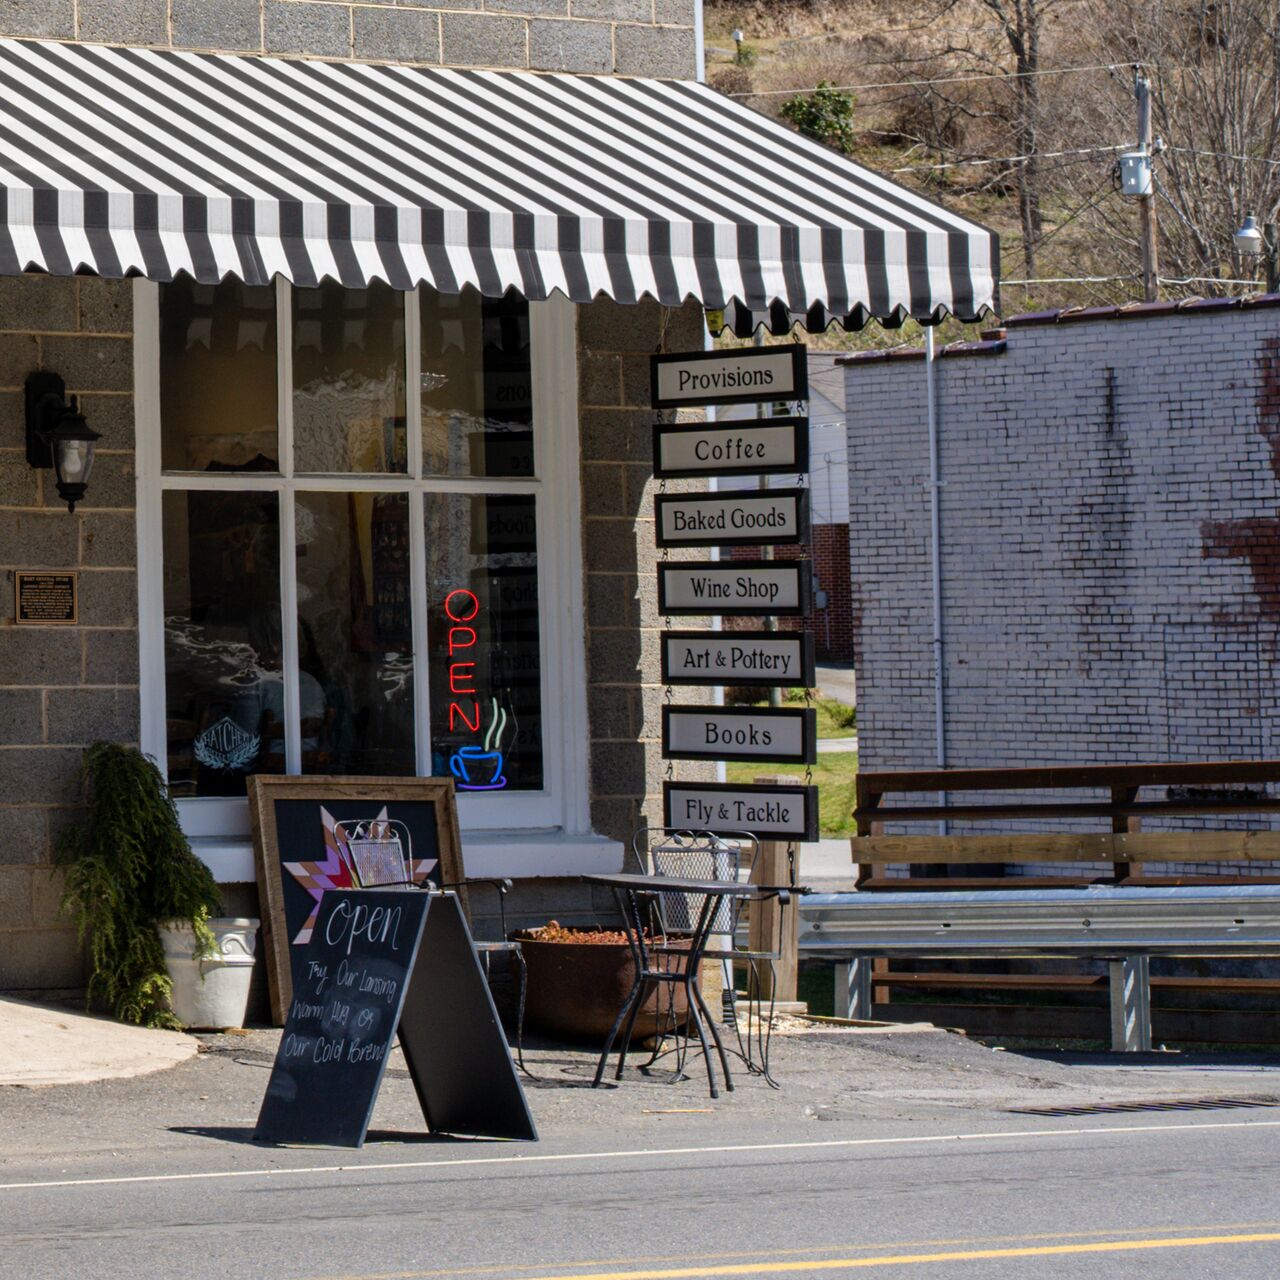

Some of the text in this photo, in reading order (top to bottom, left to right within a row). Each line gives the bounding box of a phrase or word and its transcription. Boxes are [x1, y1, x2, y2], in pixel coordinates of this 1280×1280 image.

[678, 366, 774, 391] Provisions
[694, 438, 766, 461] Coffee
[673, 506, 786, 531] Baked Goods
[689, 577, 779, 602] Wine Shop
[445, 588, 480, 732] OPEN
[683, 647, 791, 674] Art & Pottery
[705, 722, 772, 746] Books
[686, 799, 790, 825] Fly & Tackle
[325, 898, 402, 955] Open
[308, 959, 397, 1003] Try Our Lansing
[292, 1000, 323, 1019] Warm
[284, 1033, 309, 1057] Our
[313, 1036, 344, 1063] Cold
